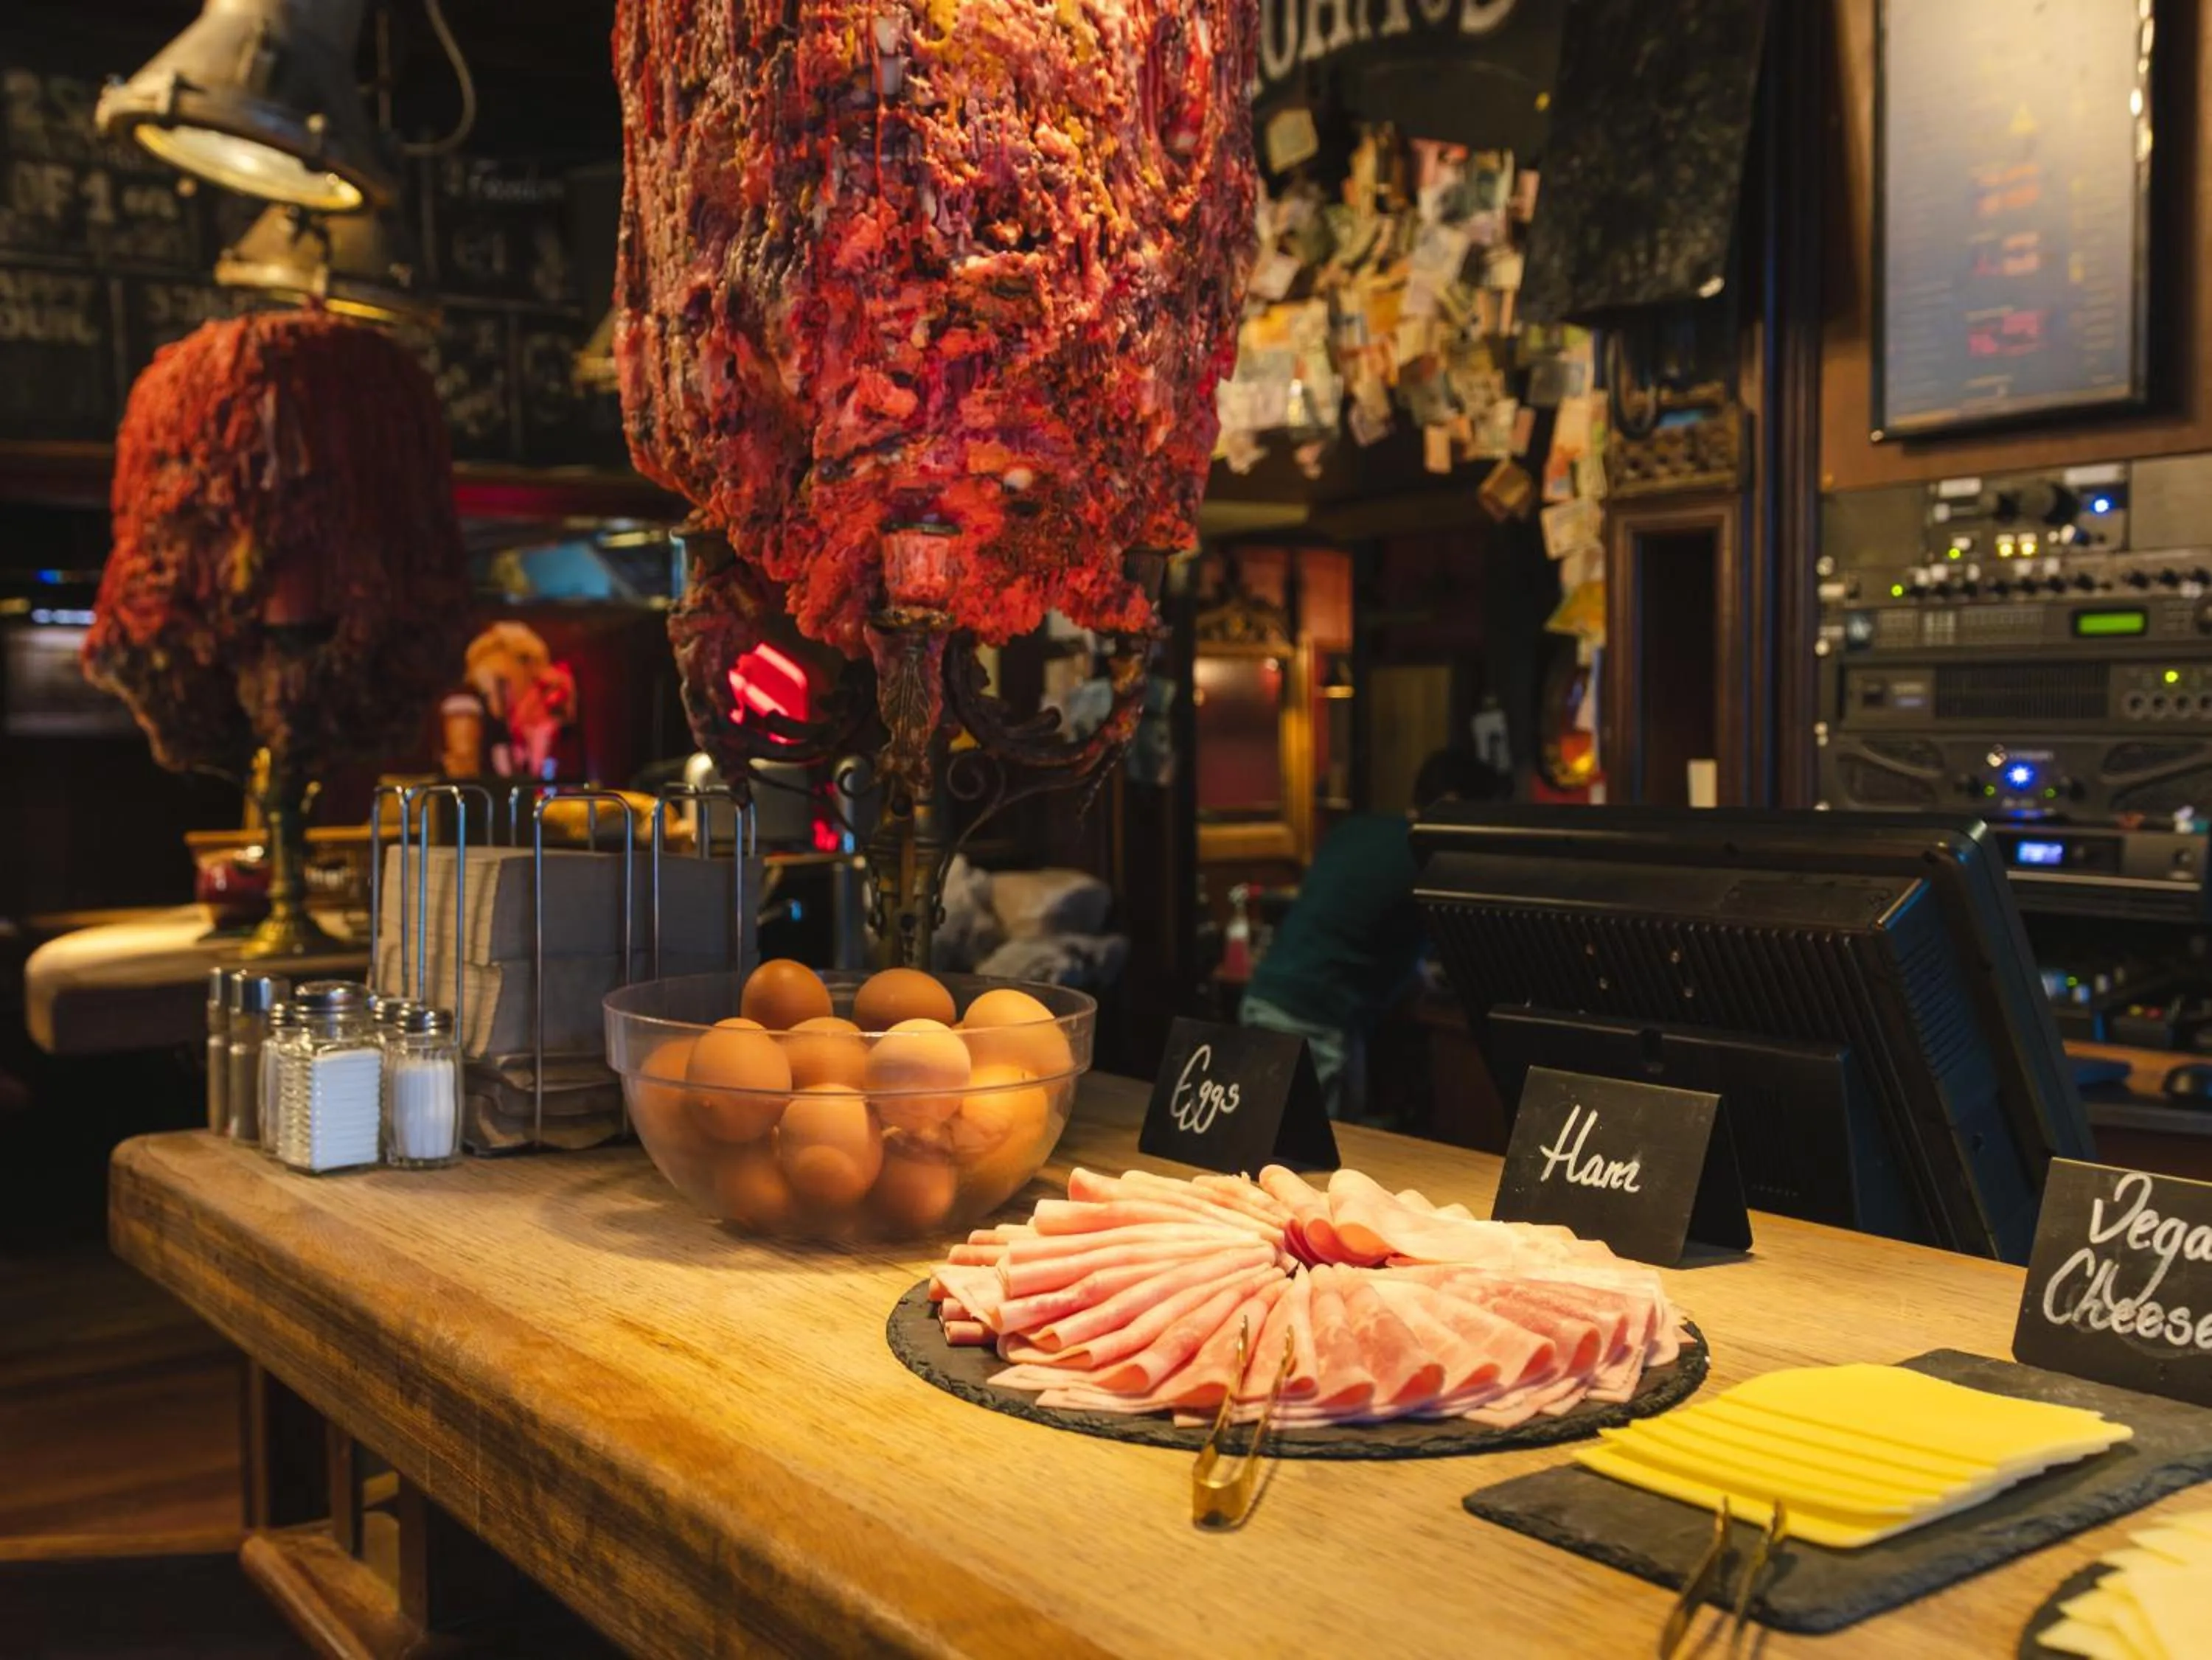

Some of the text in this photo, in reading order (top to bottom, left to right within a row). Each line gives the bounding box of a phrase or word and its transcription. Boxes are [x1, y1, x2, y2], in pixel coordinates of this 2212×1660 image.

[1170, 1044, 1239, 1134] Eggs
[1539, 1104, 1641, 1193] Ham
[2042, 1246, 2212, 1350] Cheese
